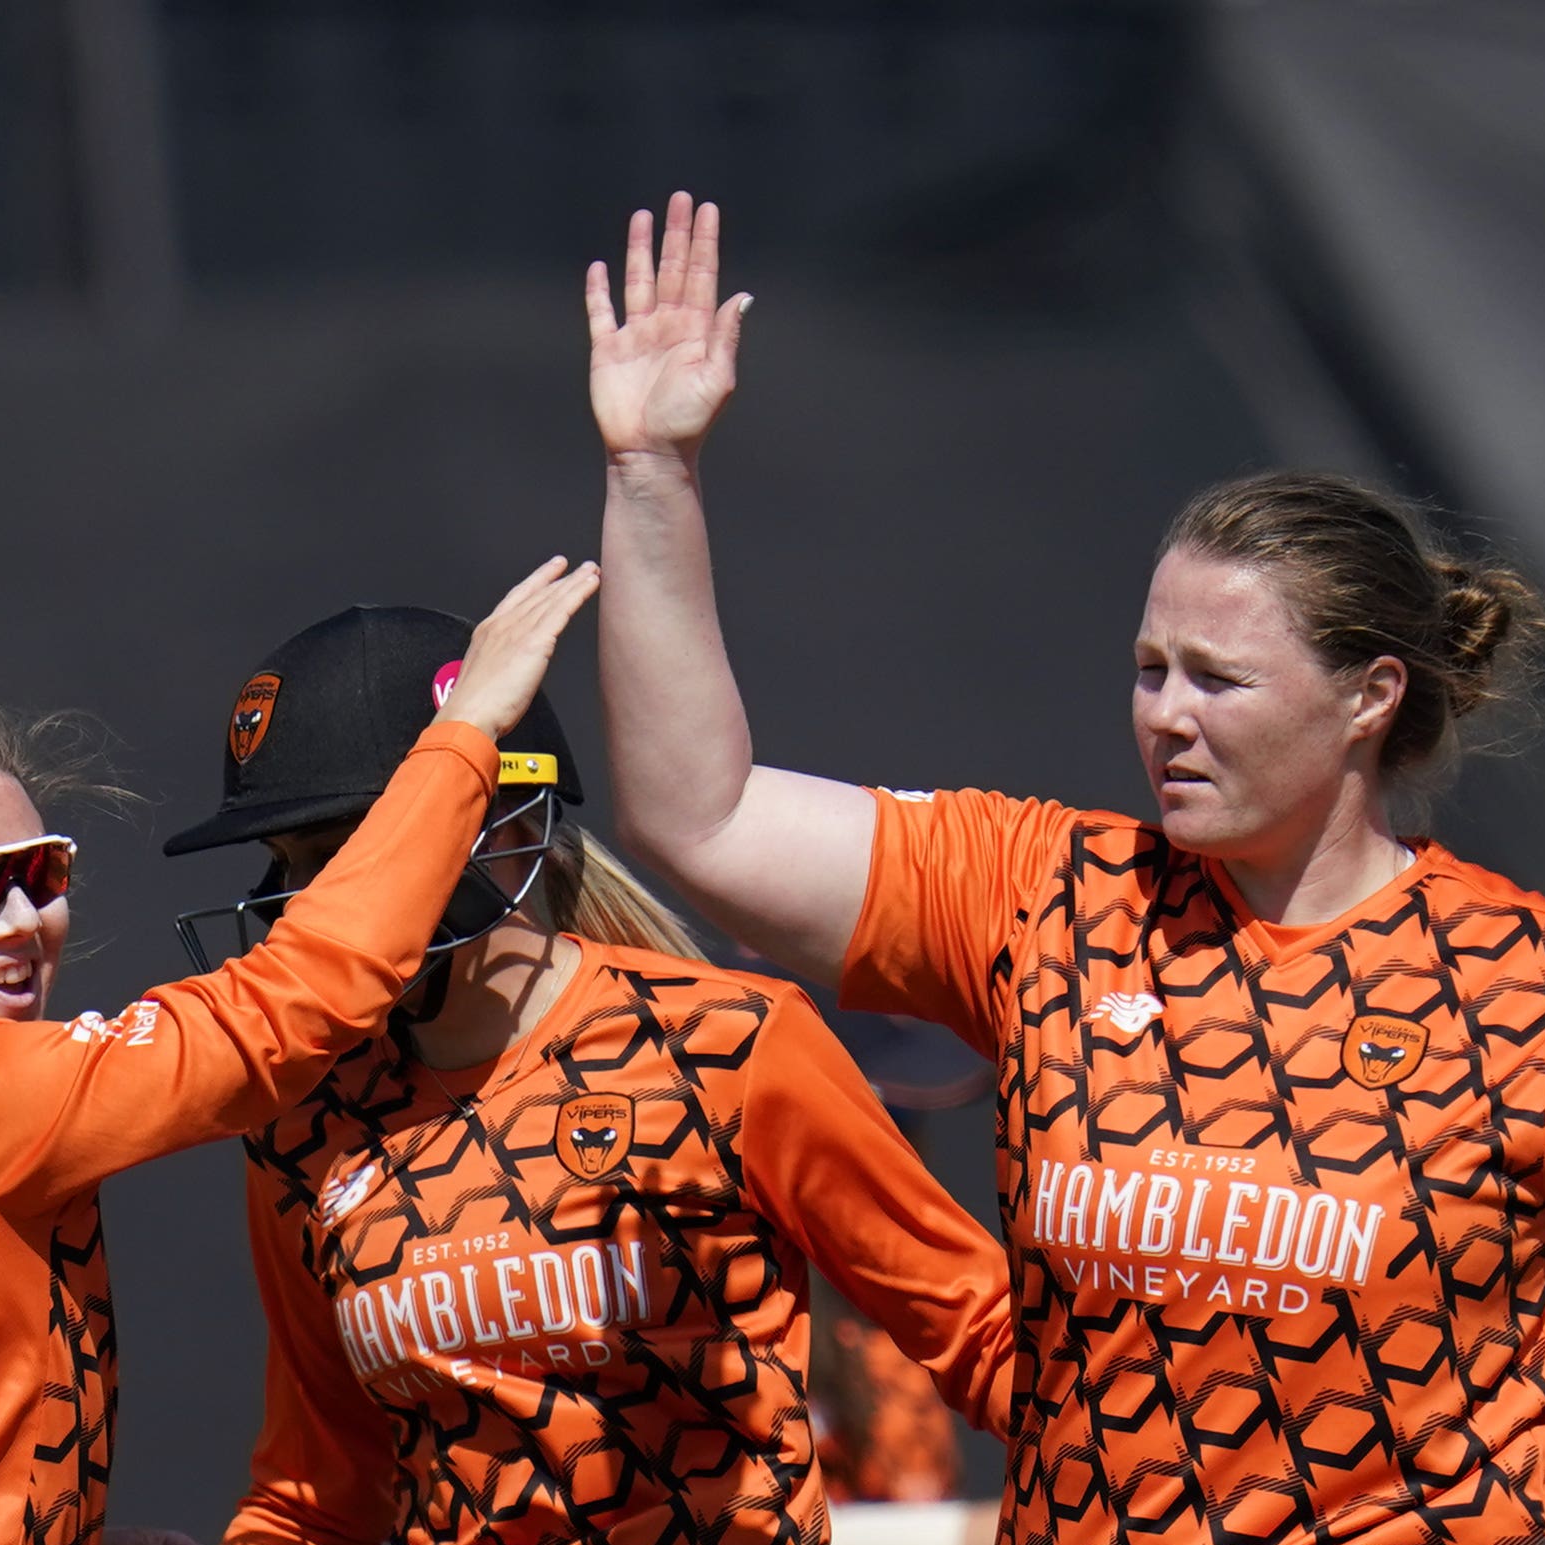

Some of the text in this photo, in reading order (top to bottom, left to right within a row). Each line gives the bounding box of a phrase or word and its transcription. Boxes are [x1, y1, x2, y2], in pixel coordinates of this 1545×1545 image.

[566, 1107, 628, 1124] VIPERS
[1204, 1154, 1257, 1175] 1952
[462, 1231, 511, 1256] 1952
[1033, 1159, 1387, 1287] HAMBLEDON
[335, 1240, 652, 1378] HAMBLEDON
[1063, 1257, 1310, 1315] VINEYARD
[386, 1340, 613, 1401] VINEYARD
